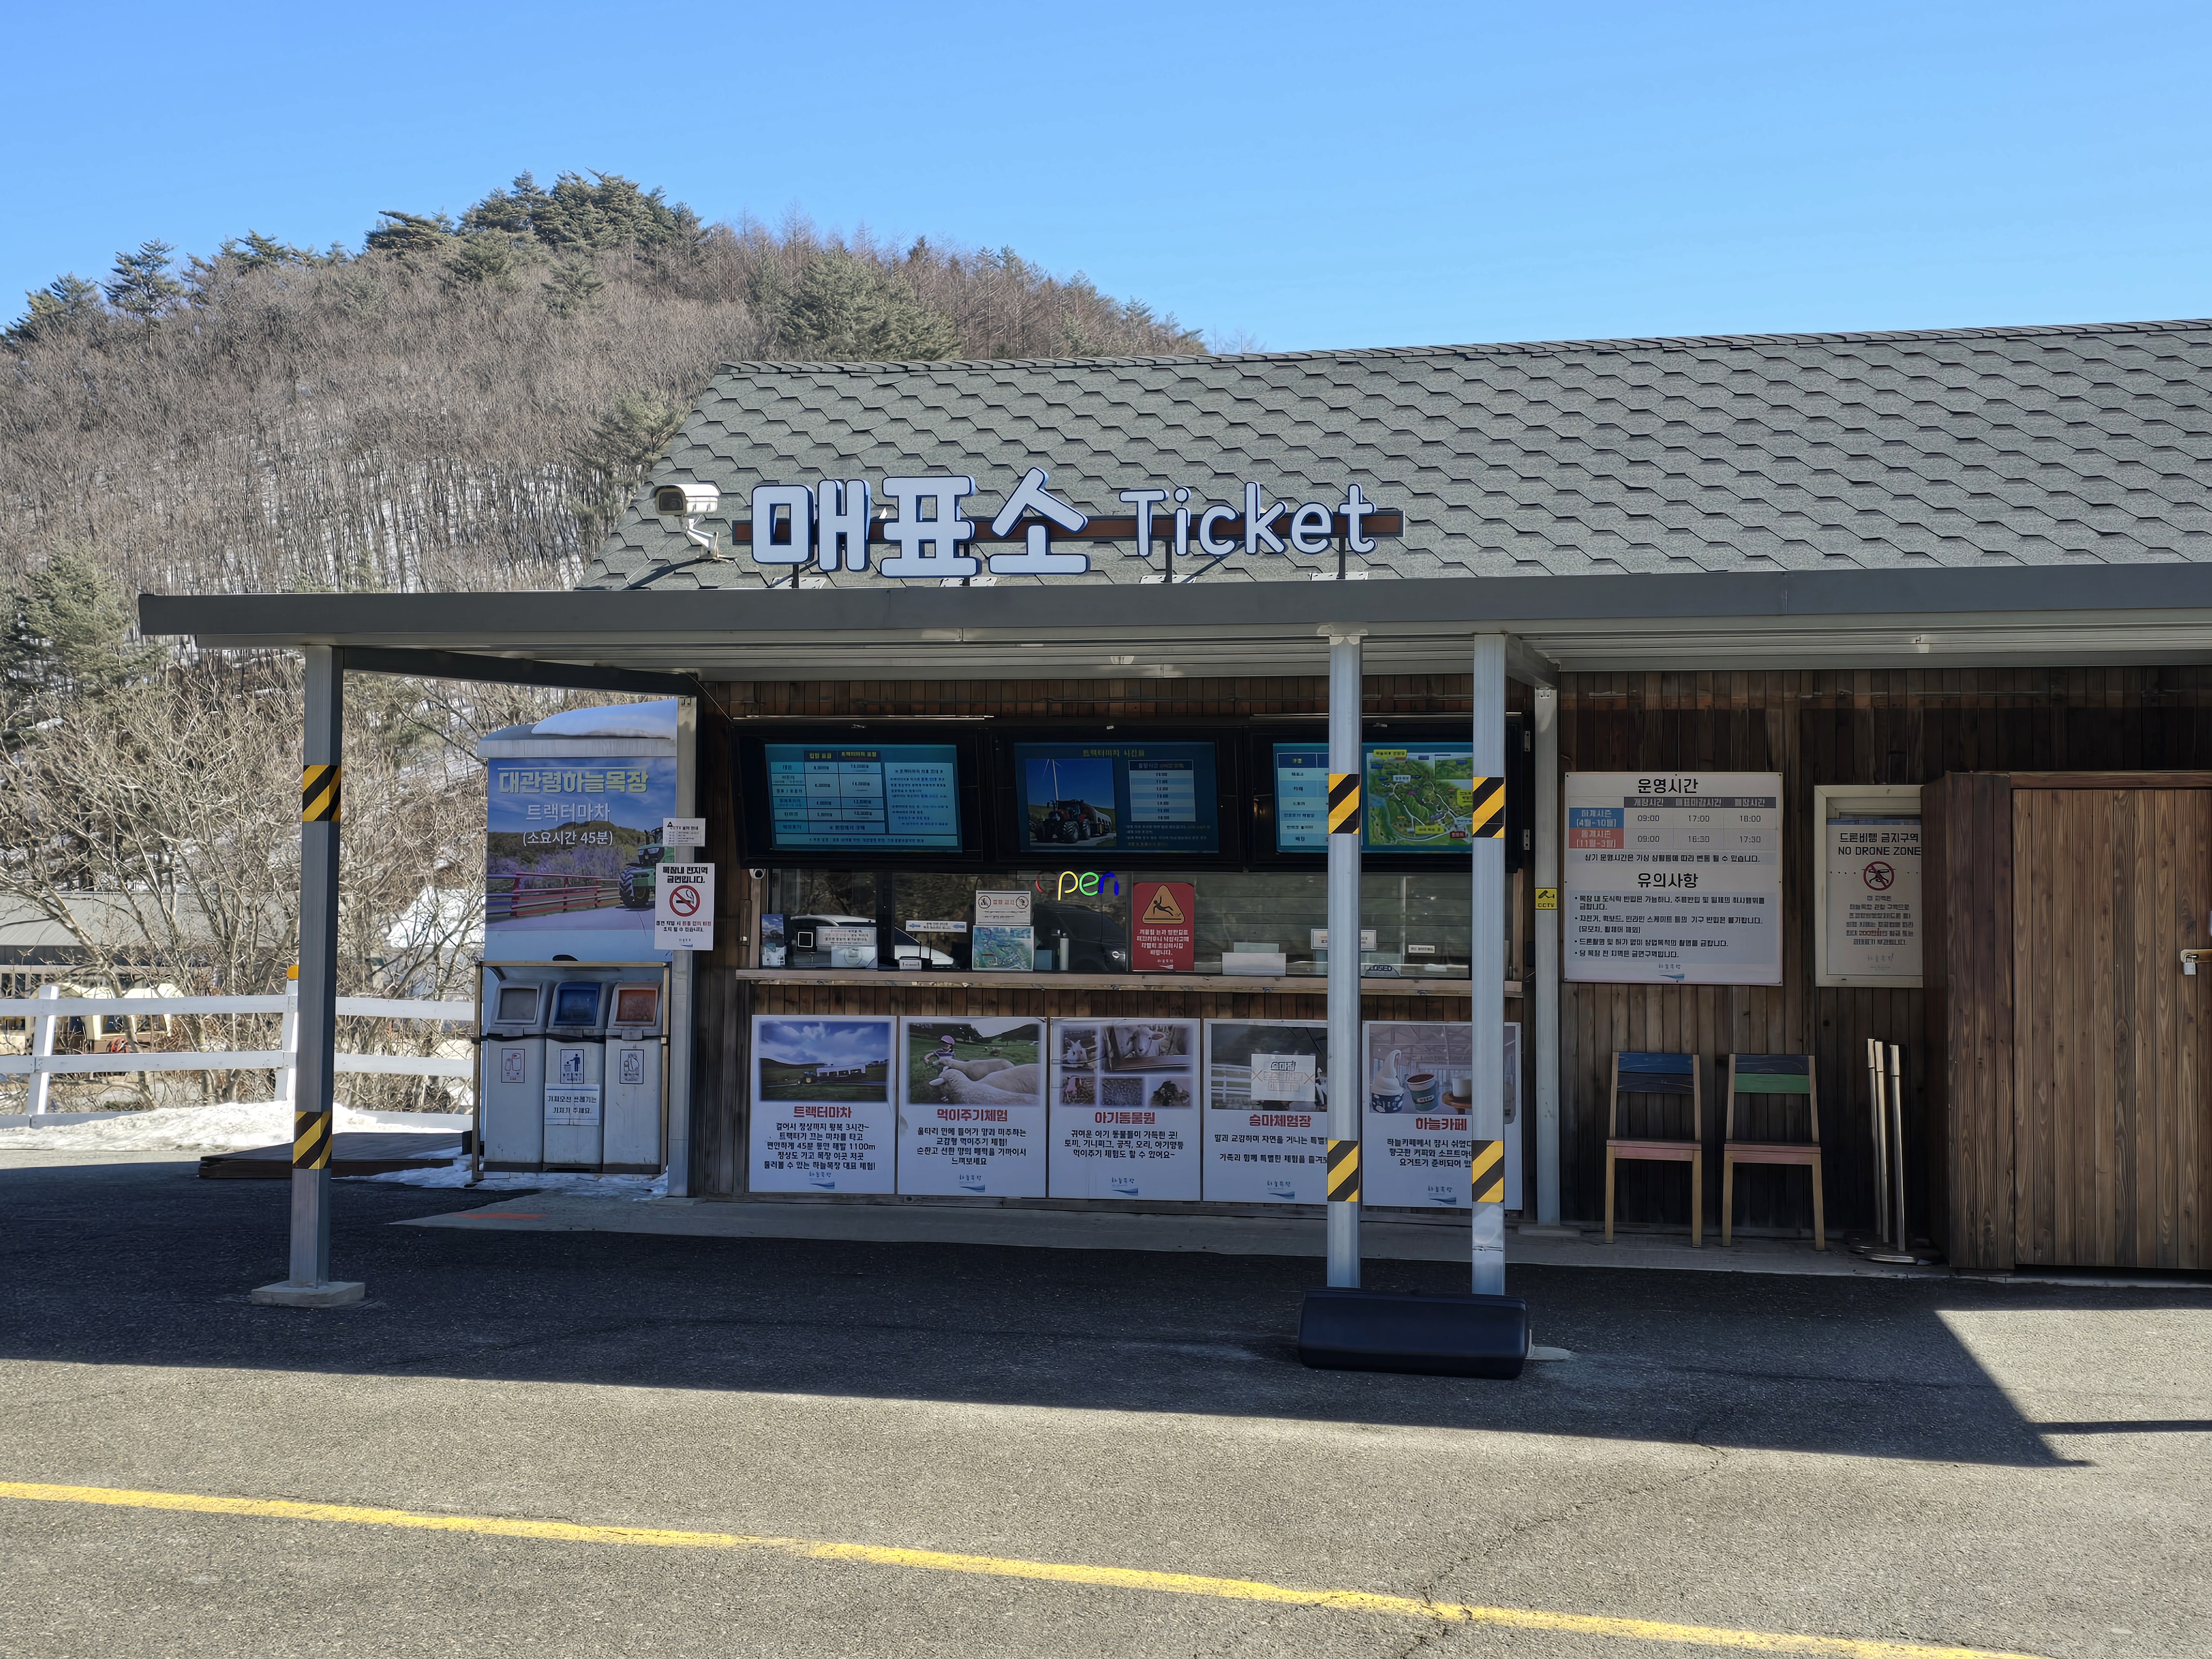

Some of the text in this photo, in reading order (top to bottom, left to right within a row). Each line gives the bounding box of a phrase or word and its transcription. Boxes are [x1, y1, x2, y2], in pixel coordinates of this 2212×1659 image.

[751, 467, 1090, 577] 매표소
[1118, 481, 1377, 556] Ticket
[499, 771, 649, 793] 대관령하늘목장
[1637, 778, 1698, 794] 운영시간
[1634, 798, 1663, 806] 개장시간
[526, 803, 611, 821] 트랙터마차
[523, 831, 613, 846] (소요시간 45분)
[1881, 833, 1918, 843] 금지구역
[1838, 847, 1921, 855] NO DRONE ZONE
[1637, 873, 1698, 888] 유의사항
[794, 1107, 852, 1118] 트랙터마차
[937, 1109, 1008, 1121] 먹이주기체험
[1095, 1112, 1155, 1124] 아기동물원
[1250, 1114, 1311, 1127] 승마체험장
[1416, 1118, 1467, 1131] 하늘카페
[776, 1123, 796, 1131] 걸어서
[998, 1129, 1026, 1137] 마주하는
[1286, 1136, 1307, 1144] 거니는
[1432, 1159, 1460, 1167] 준비되어
